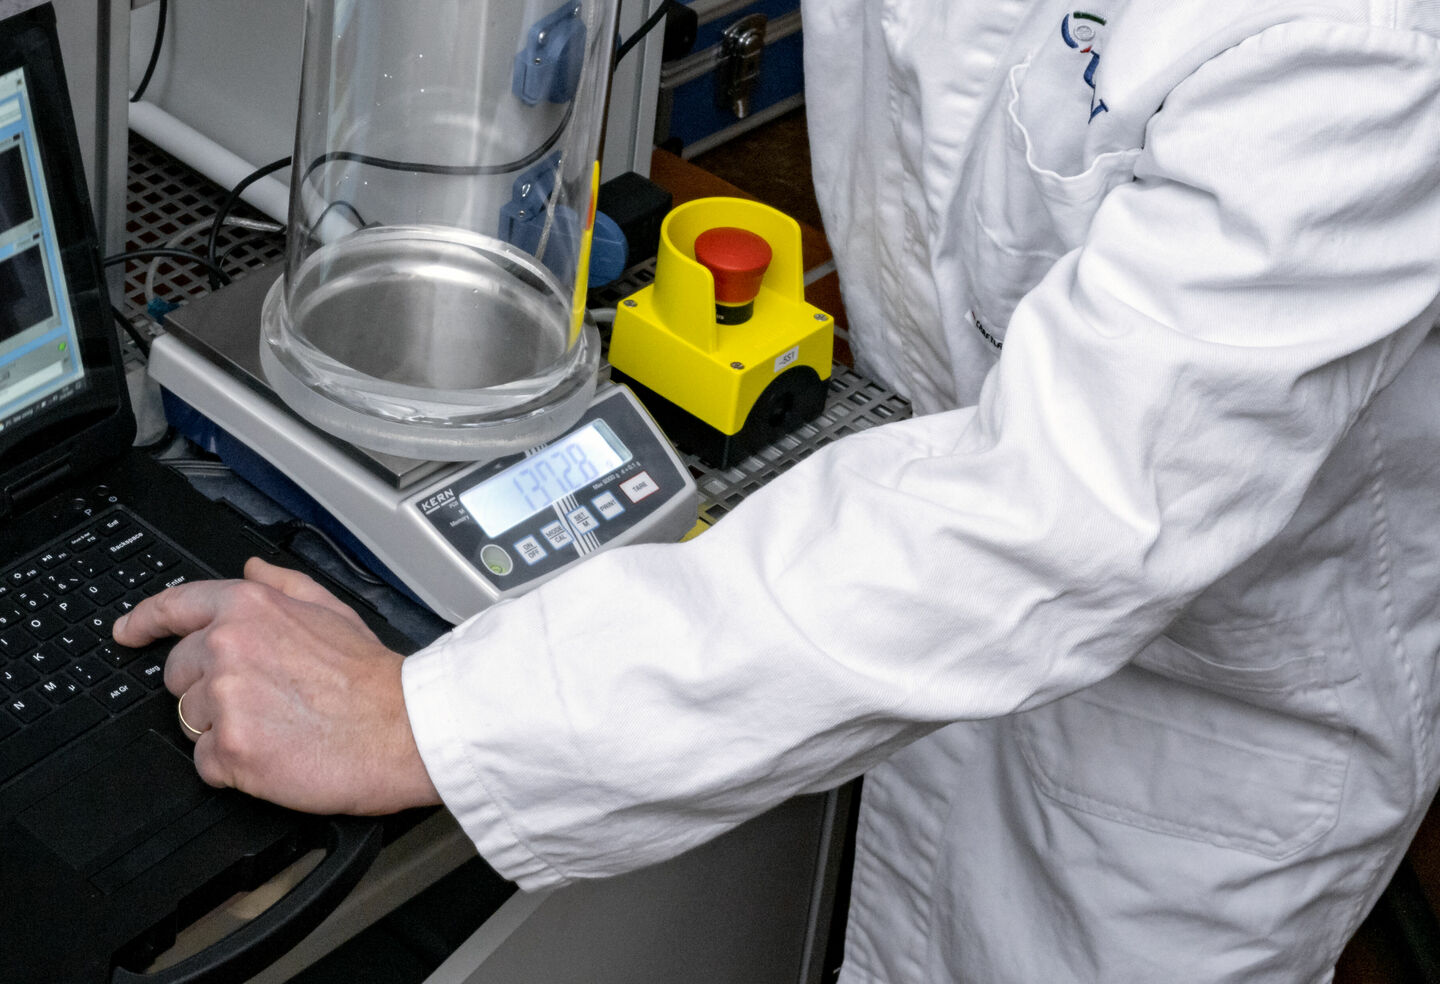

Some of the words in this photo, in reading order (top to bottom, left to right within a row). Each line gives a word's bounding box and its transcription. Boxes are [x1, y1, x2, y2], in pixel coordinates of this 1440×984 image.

[632, 481, 648, 492] TARE
[421, 488, 454, 511] KERN
[599, 500, 616, 512] PRINT
[449, 515, 470, 527] Memory
[545, 525, 563, 537] MODE
[110, 532, 144, 553] Backspace
[554, 534, 567, 544] CAL
[522, 542, 534, 551] ON
[528, 550, 540, 559] OFF
[165, 575, 185, 589] Enter
[59, 602, 68, 611] P
[31, 619, 41, 628] O
[62, 636, 73, 645] L
[32, 653, 45, 662] K
[5, 671, 12, 680] J
[145, 665, 160, 676] Strg
[44, 681, 57, 691] M
[110, 690, 121, 699] Alt
[119, 684, 129, 693] Gr
[13, 701, 25, 710] N
